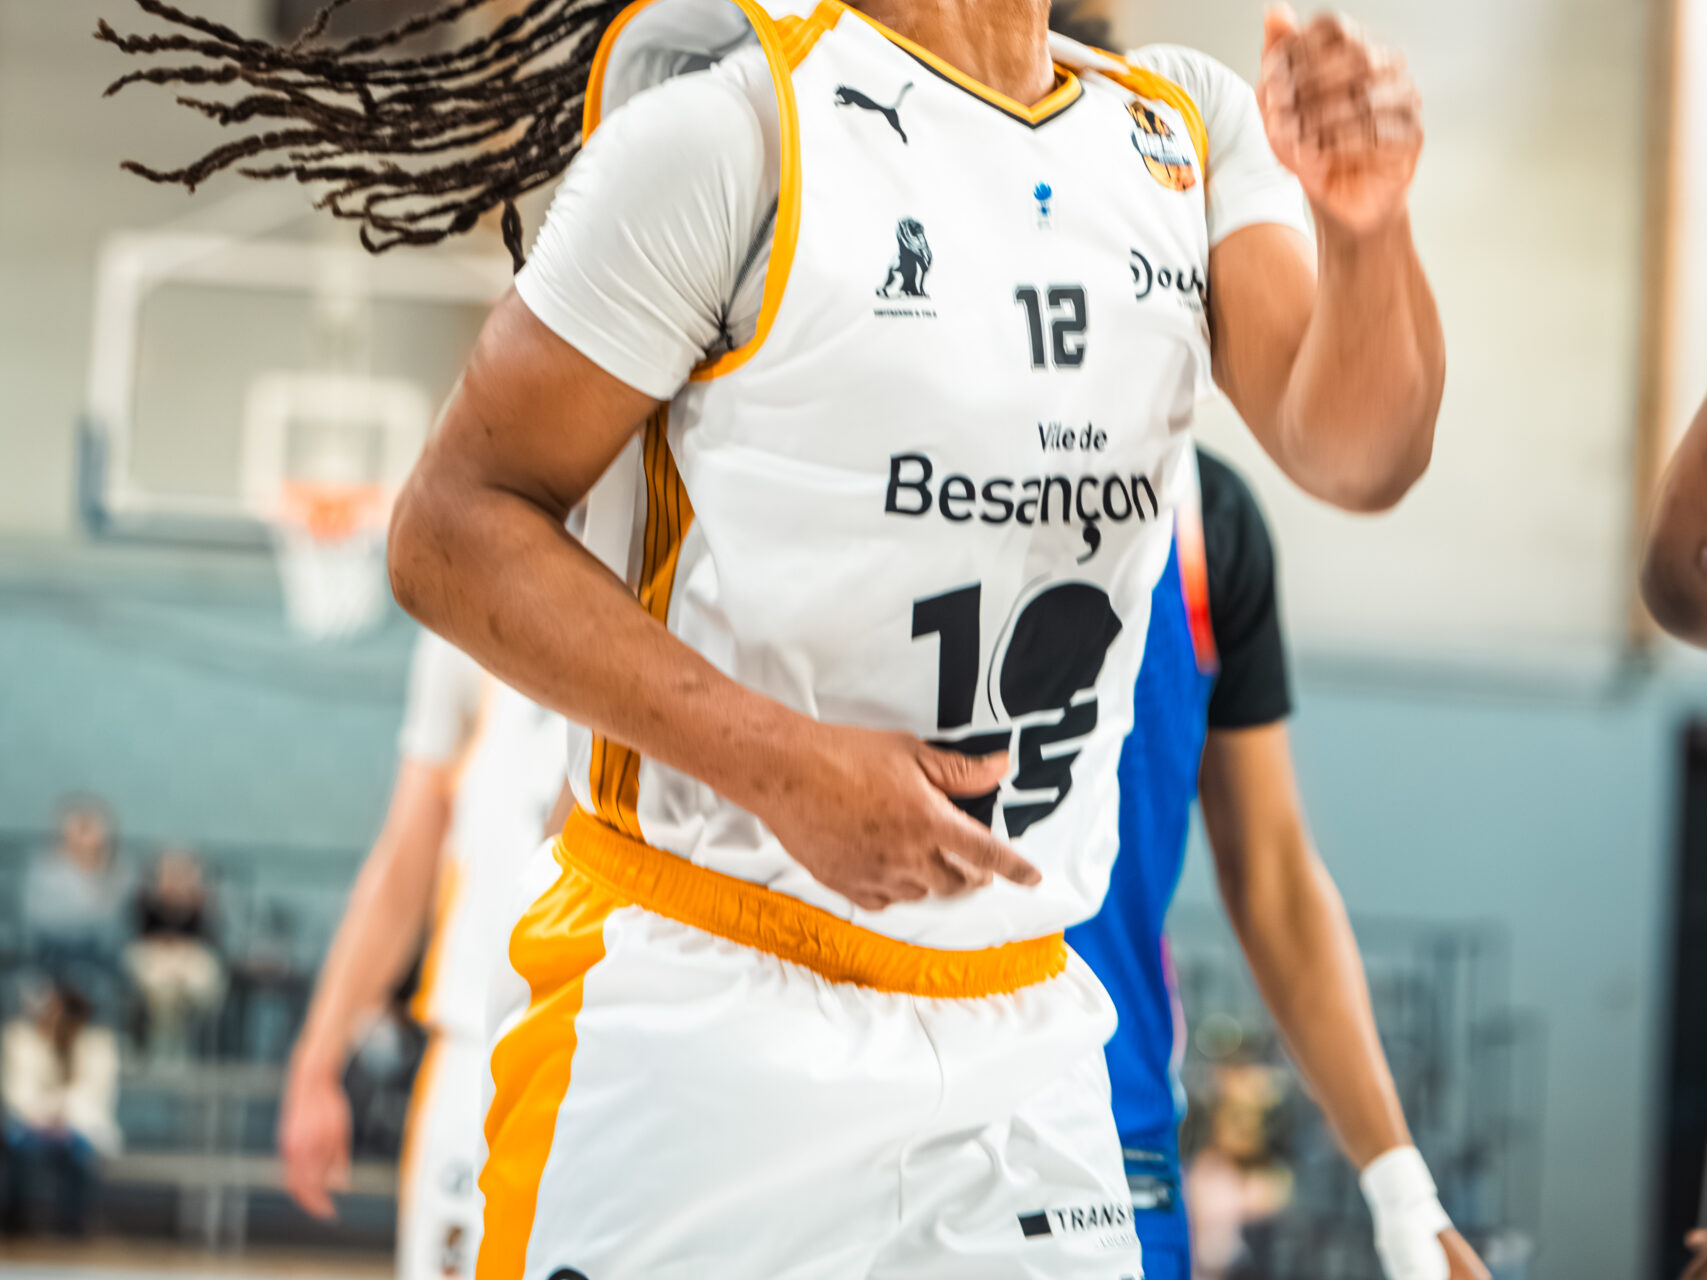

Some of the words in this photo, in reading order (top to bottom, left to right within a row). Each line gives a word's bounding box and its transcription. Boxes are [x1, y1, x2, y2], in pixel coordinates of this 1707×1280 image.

[1013, 282, 1088, 370] 12
[1079, 420, 1107, 452] de
[884, 453, 1159, 565] Besançon
